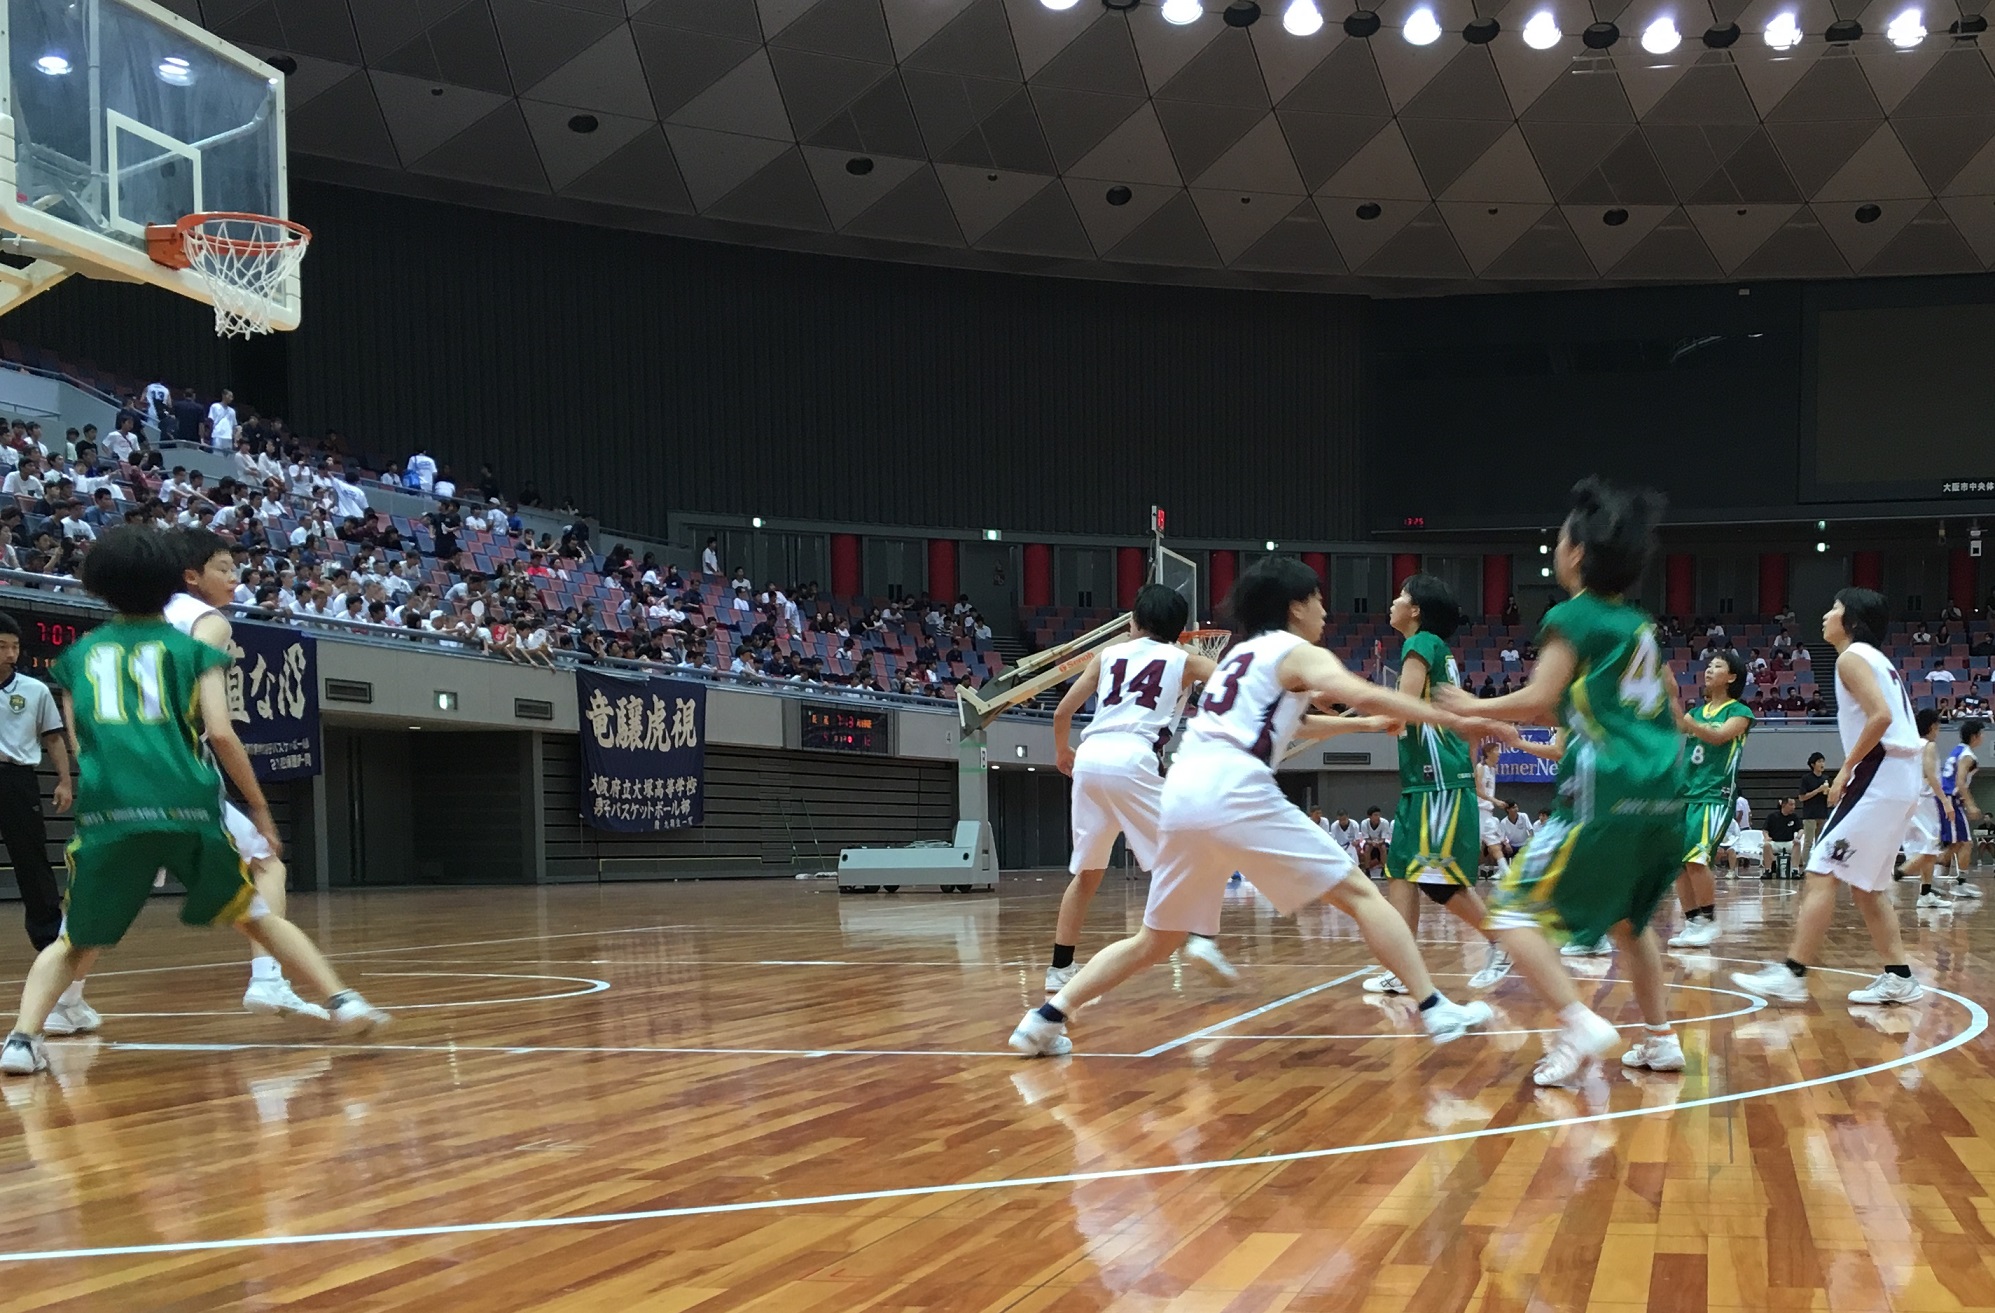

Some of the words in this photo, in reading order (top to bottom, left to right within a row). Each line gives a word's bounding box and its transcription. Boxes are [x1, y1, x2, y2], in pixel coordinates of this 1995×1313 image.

[1067, 651, 1095, 669] Senoh
[1619, 623, 1665, 719] 4
[85, 640, 170, 724] 11
[1103, 658, 1167, 711] 14
[585, 688, 698, 752] 竜驤虎視
[1691, 744, 1705, 765] 8
[589, 772, 698, 799] 大阪府立大塚高等学校
[594, 797, 691, 820] 男子バスケットボール部
